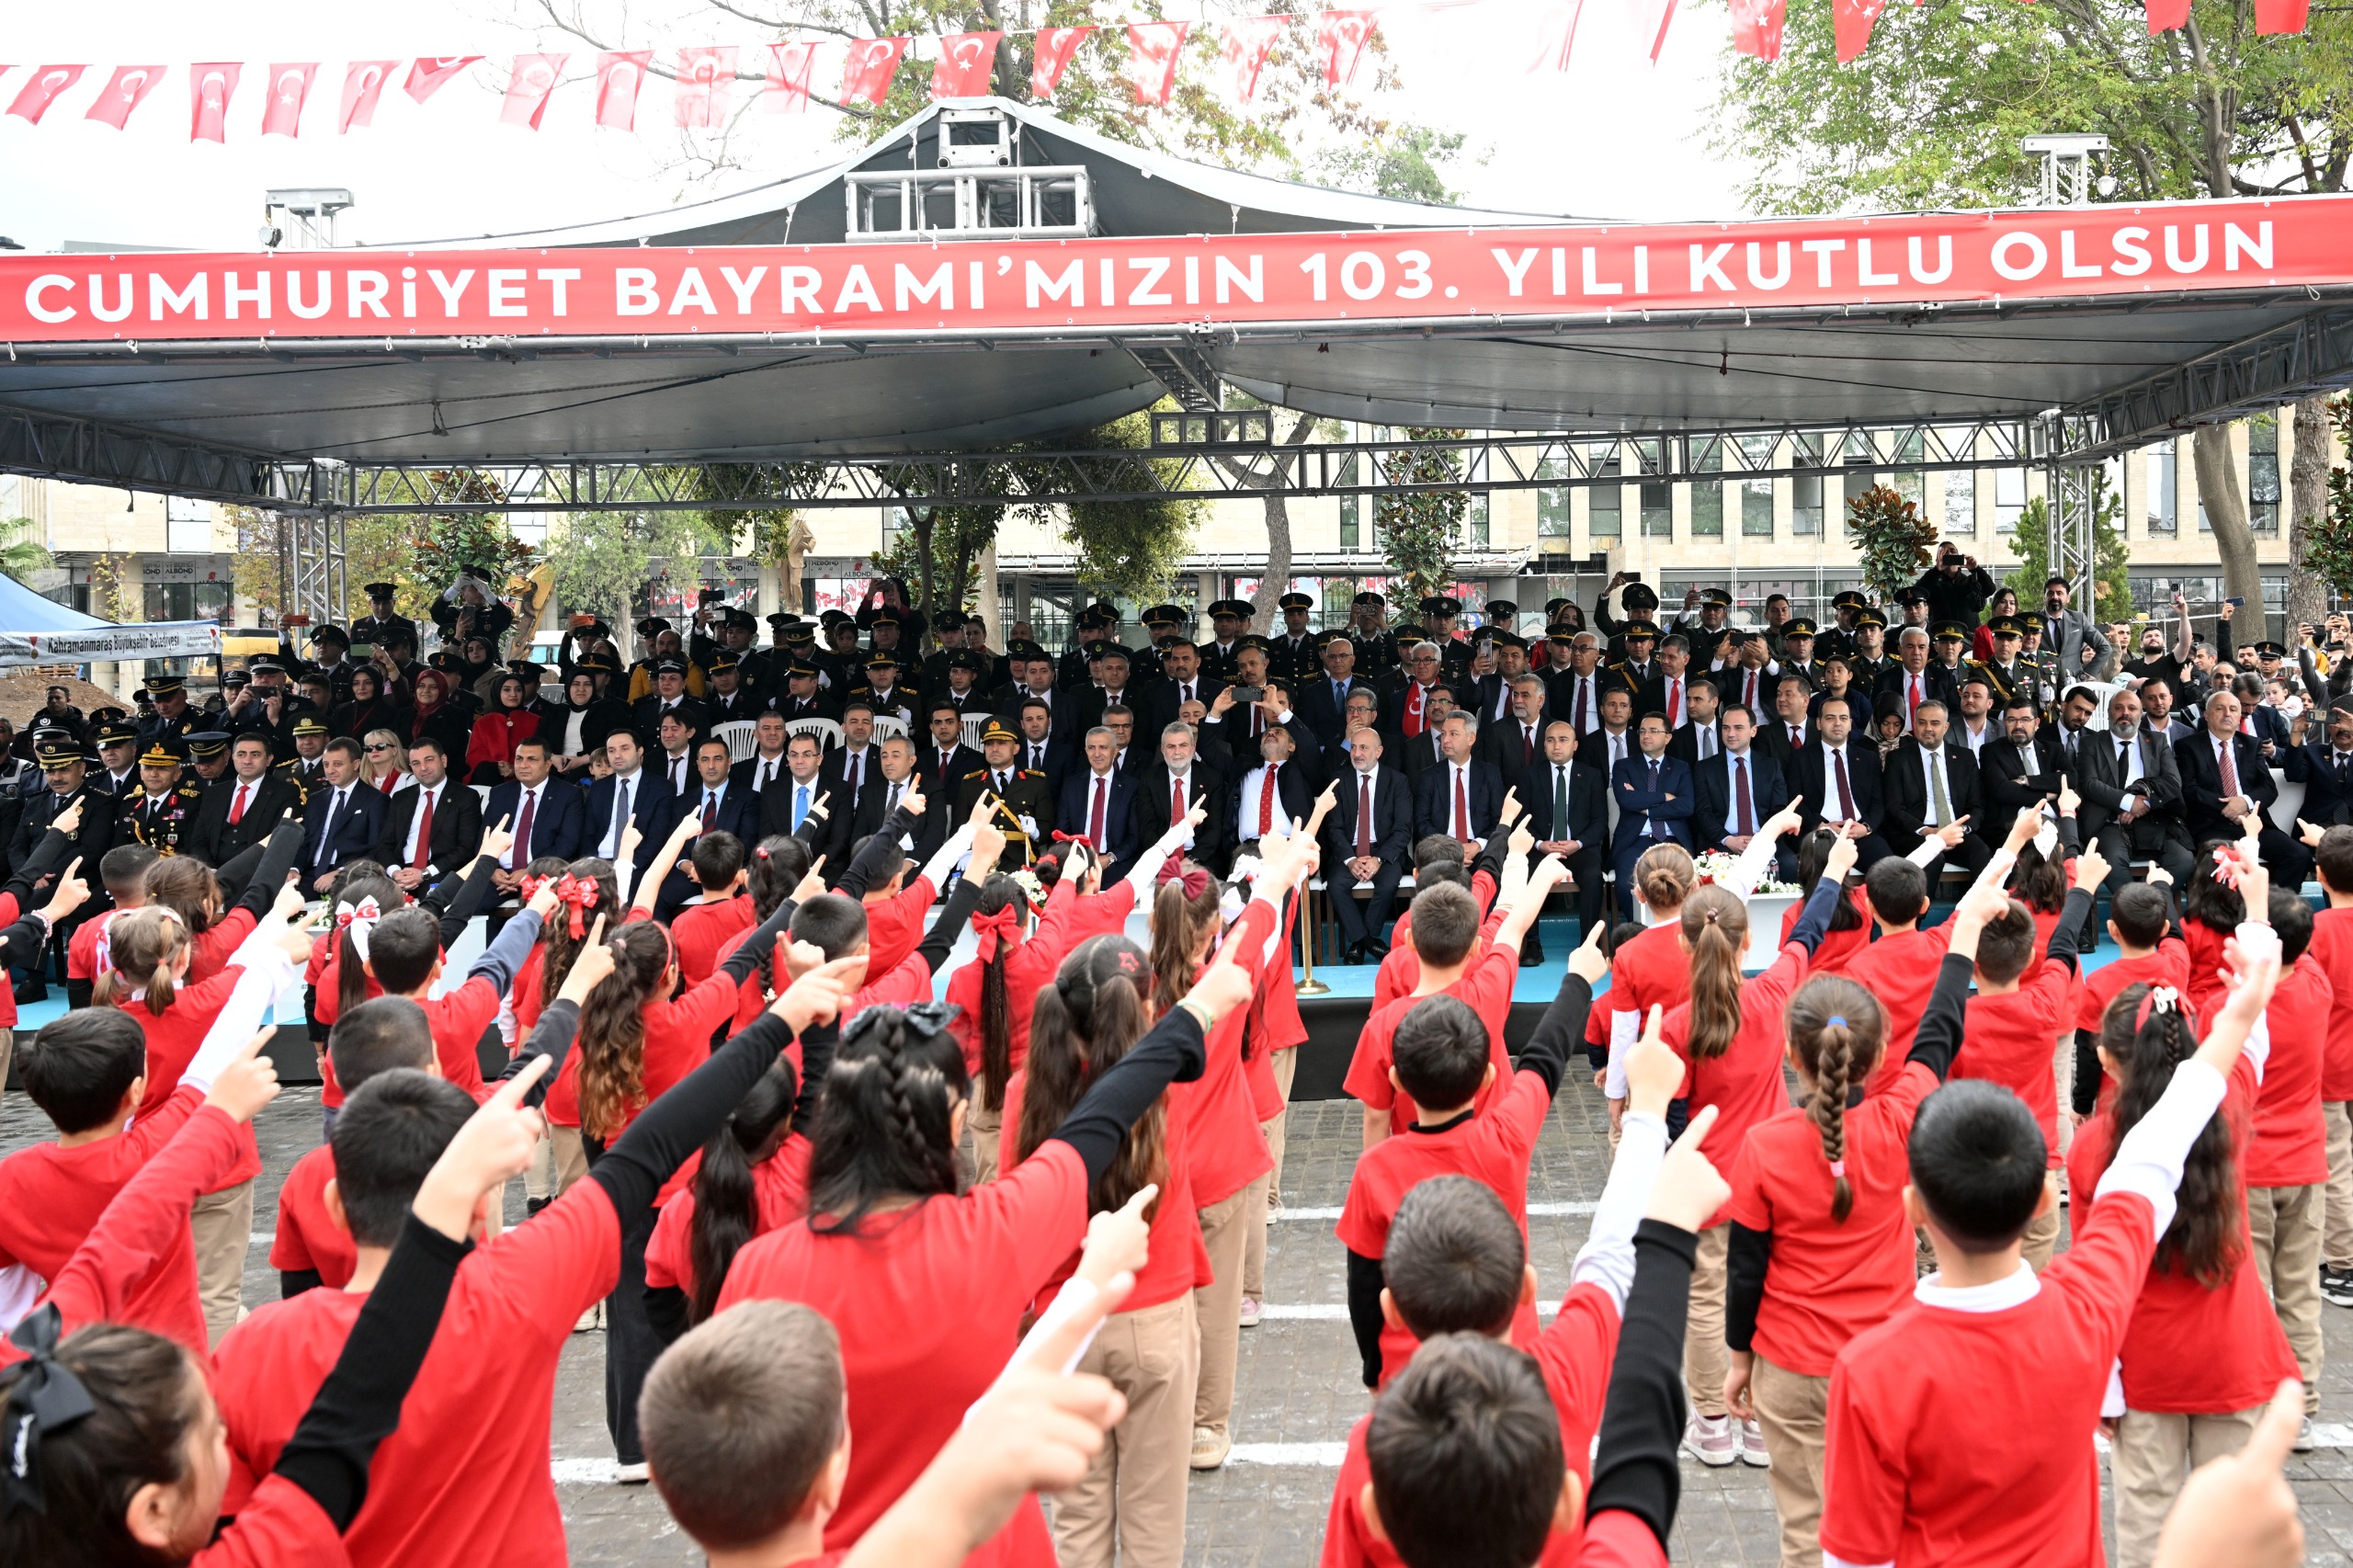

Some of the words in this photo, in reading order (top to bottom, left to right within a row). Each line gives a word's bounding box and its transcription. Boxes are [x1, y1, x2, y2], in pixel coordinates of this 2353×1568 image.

[615, 254, 1265, 316] BAYRAMI'MIZIN
[1299, 249, 1460, 301] 103.
[1490, 245, 1649, 297] YILI
[1688, 234, 1953, 292] KUTLU
[1990, 221, 2274, 281] OLSUN
[48, 636, 112, 654] Kahramanmaraş
[114, 633, 148, 653] Büyükşehir
[149, 632, 179, 650] Belediyesi
